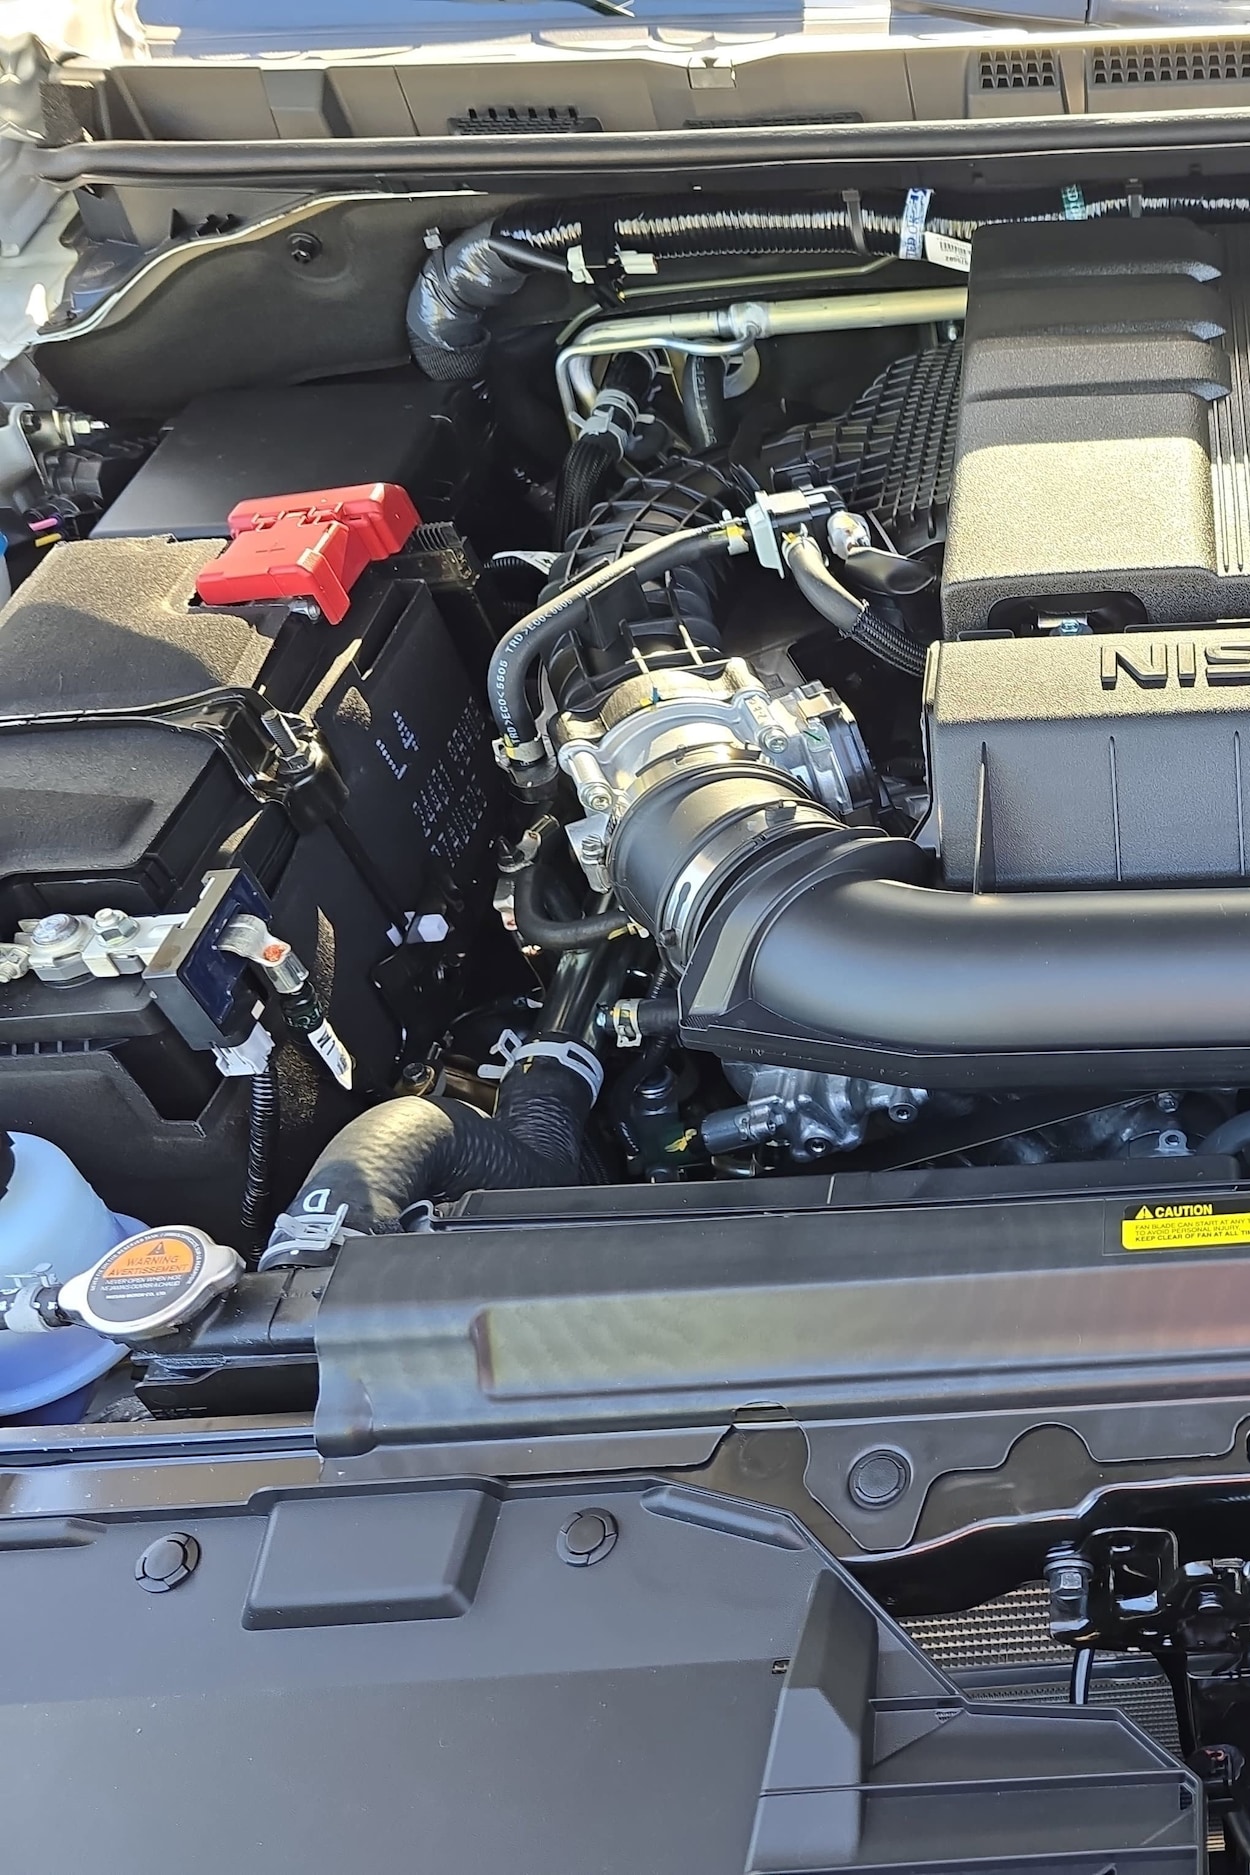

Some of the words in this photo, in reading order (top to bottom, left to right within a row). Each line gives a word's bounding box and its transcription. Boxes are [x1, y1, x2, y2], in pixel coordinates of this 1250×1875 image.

[1154, 1203, 1213, 1218] CAUTION
[1171, 1226, 1211, 1234] PERSONAL
[127, 1255, 179, 1267] WARNING
[108, 1263, 189, 1276] AVERTISSEMENT
